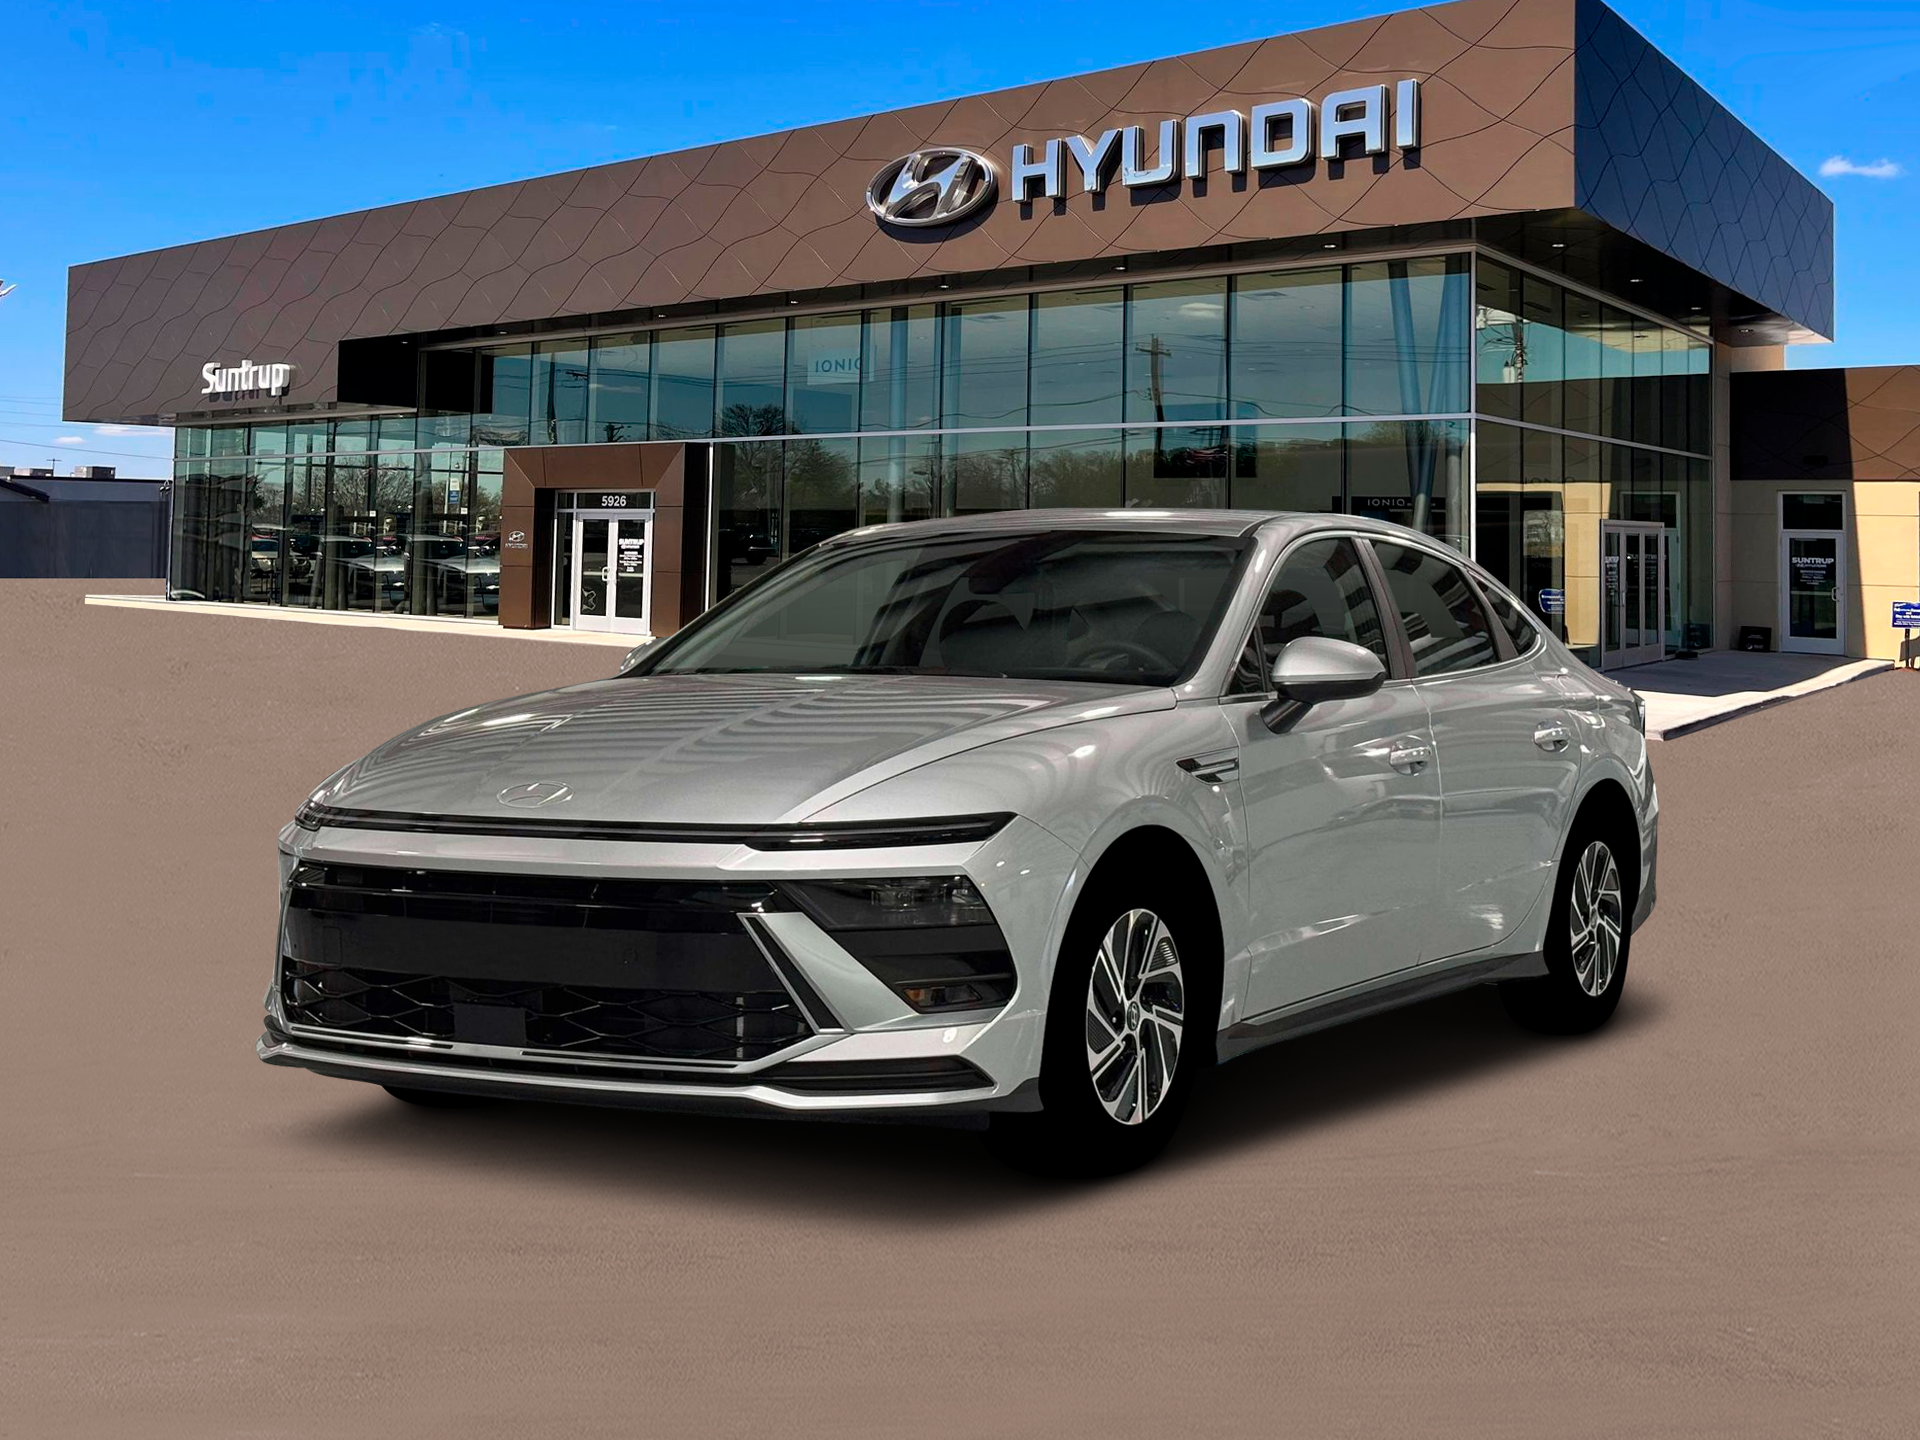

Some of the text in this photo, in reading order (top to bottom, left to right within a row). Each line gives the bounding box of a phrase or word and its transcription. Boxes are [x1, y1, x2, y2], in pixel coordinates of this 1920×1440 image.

[1011, 79, 1421, 203] HYUNDAI
[201, 360, 291, 396] Suntrup
[601, 495, 627, 507] 5926
[1791, 556, 1834, 565] SUNTRUP
